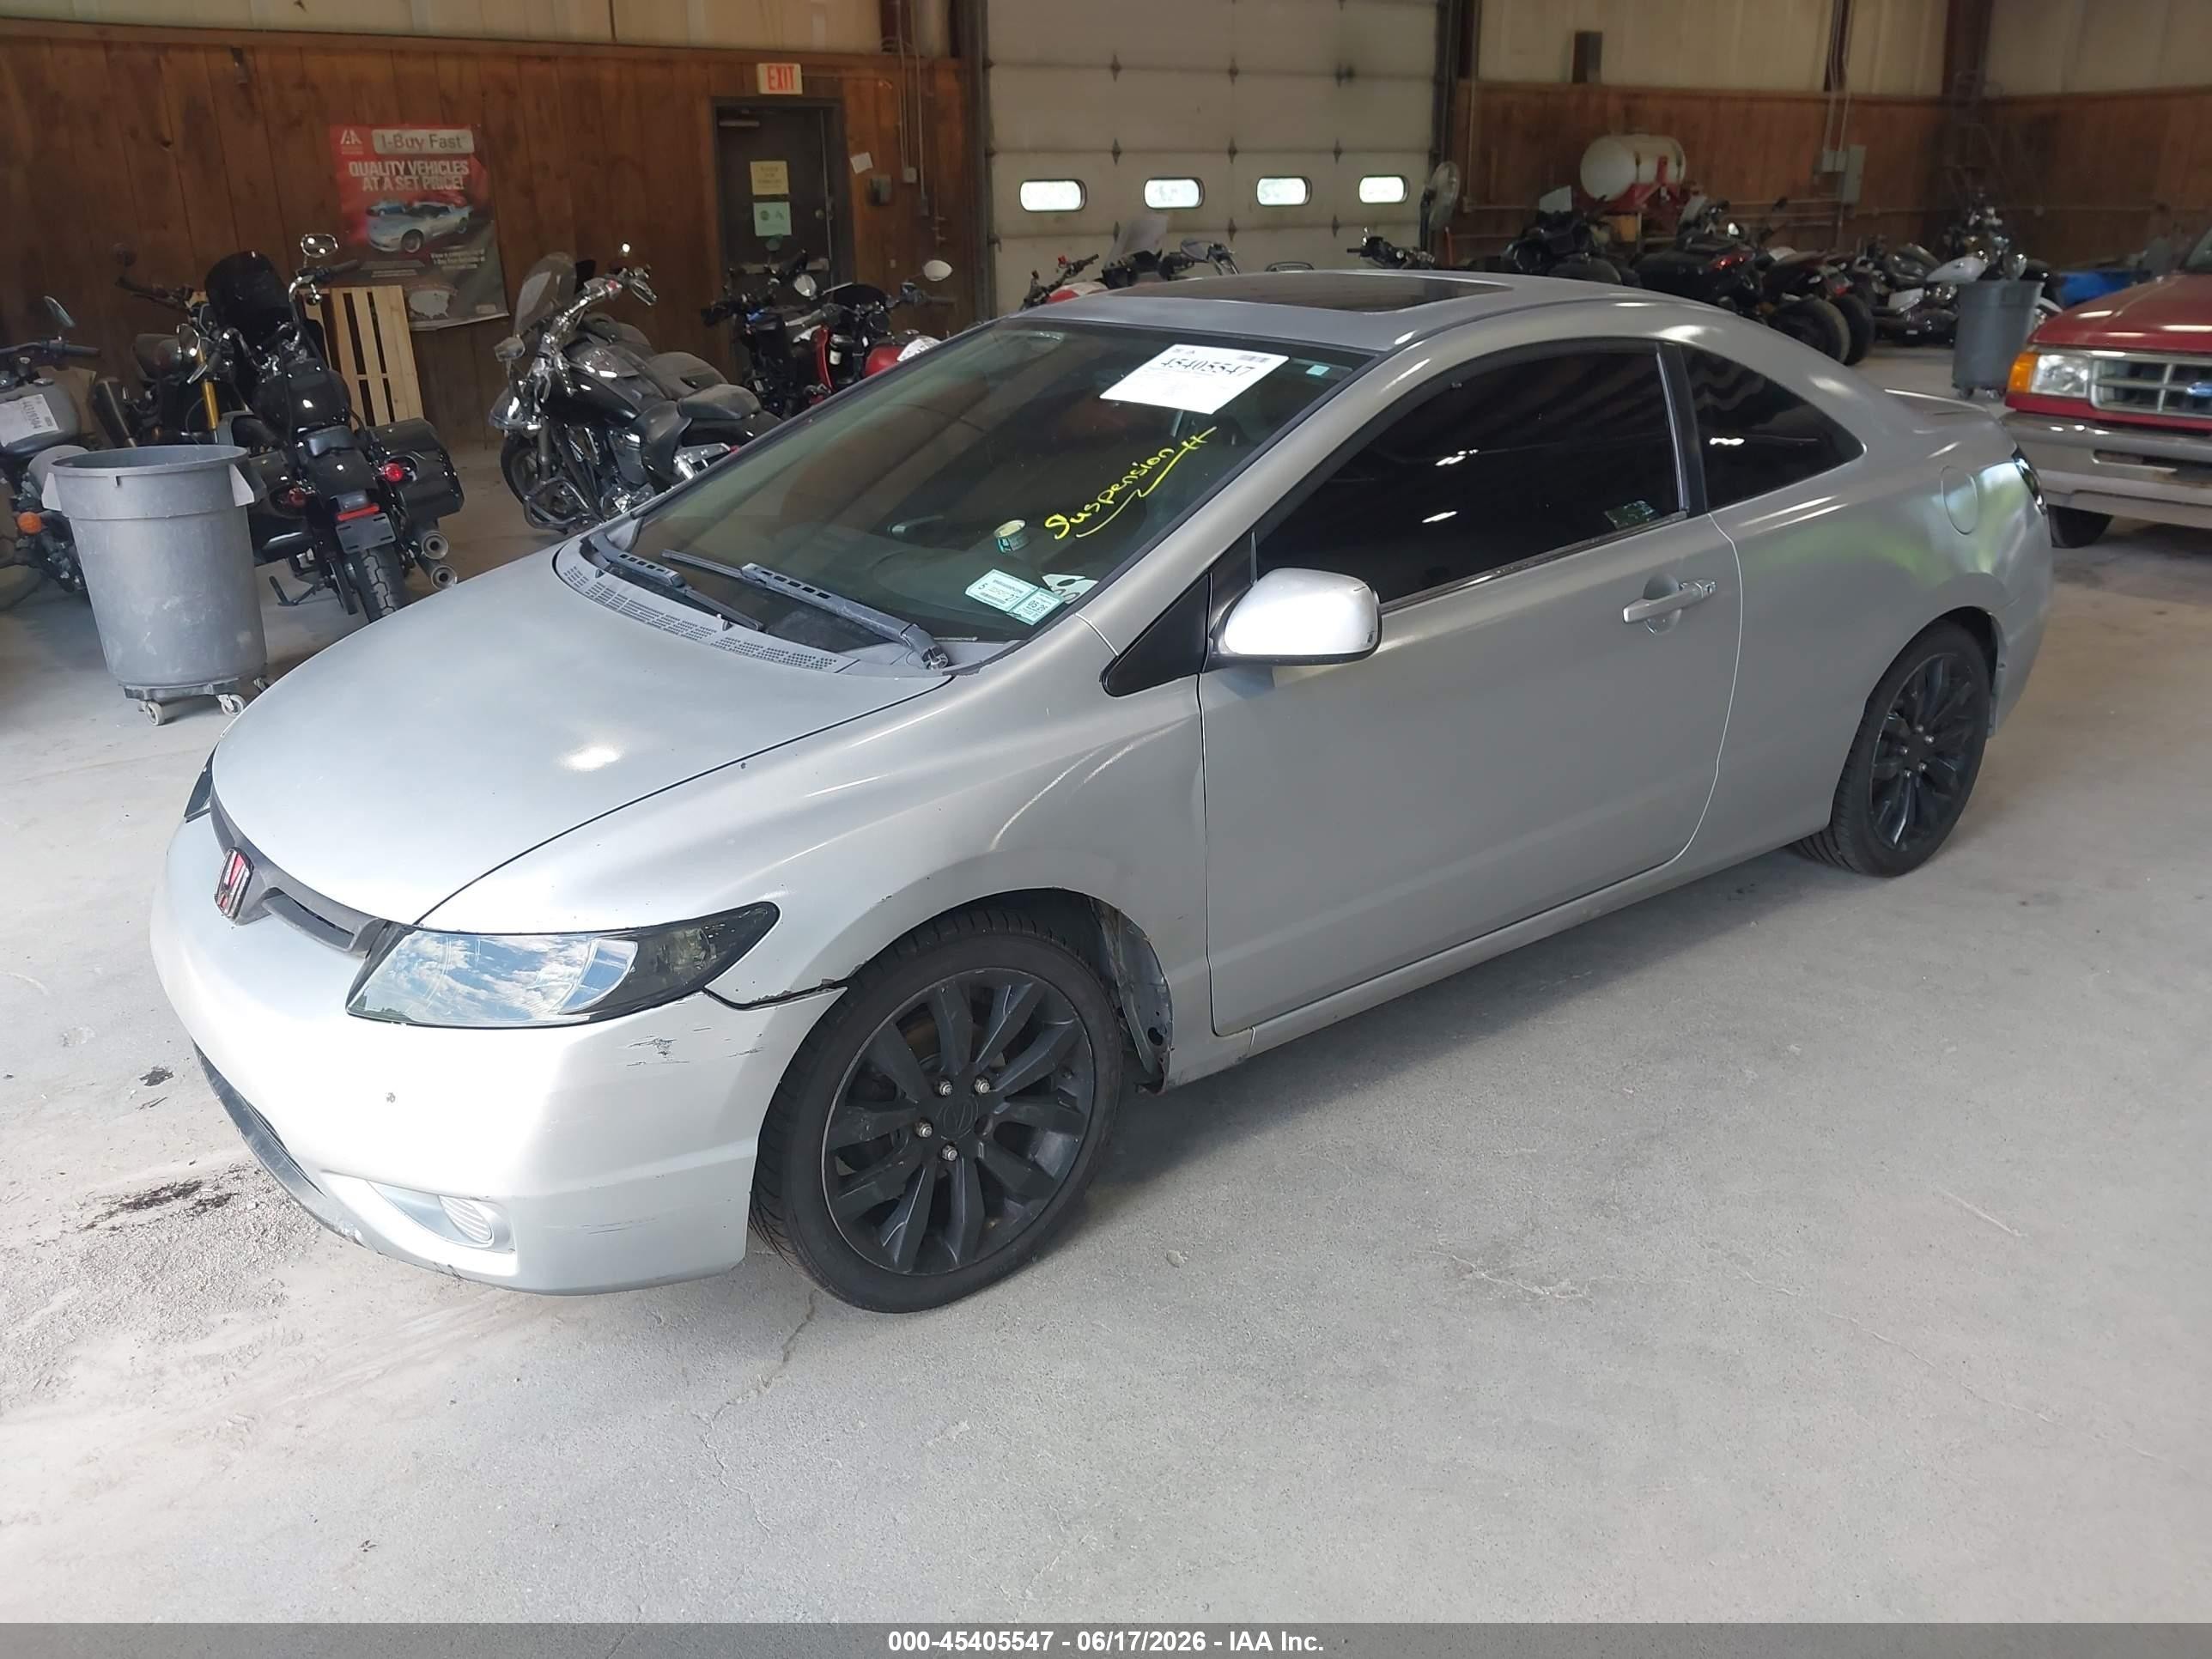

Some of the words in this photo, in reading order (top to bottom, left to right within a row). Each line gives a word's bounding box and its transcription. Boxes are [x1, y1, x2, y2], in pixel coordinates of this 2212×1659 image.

[767, 65, 794, 91] EXIT
[381, 135, 425, 151] I-Buy
[429, 134, 462, 149] Fast
[349, 161, 407, 177] QUALITY
[408, 160, 470, 176] VEHICLES
[362, 177, 381, 191] AT
[384, 177, 395, 191] A
[396, 177, 421, 191] SET
[422, 176, 465, 191] PRICE!
[1161, 357, 1255, 377] 45405547
